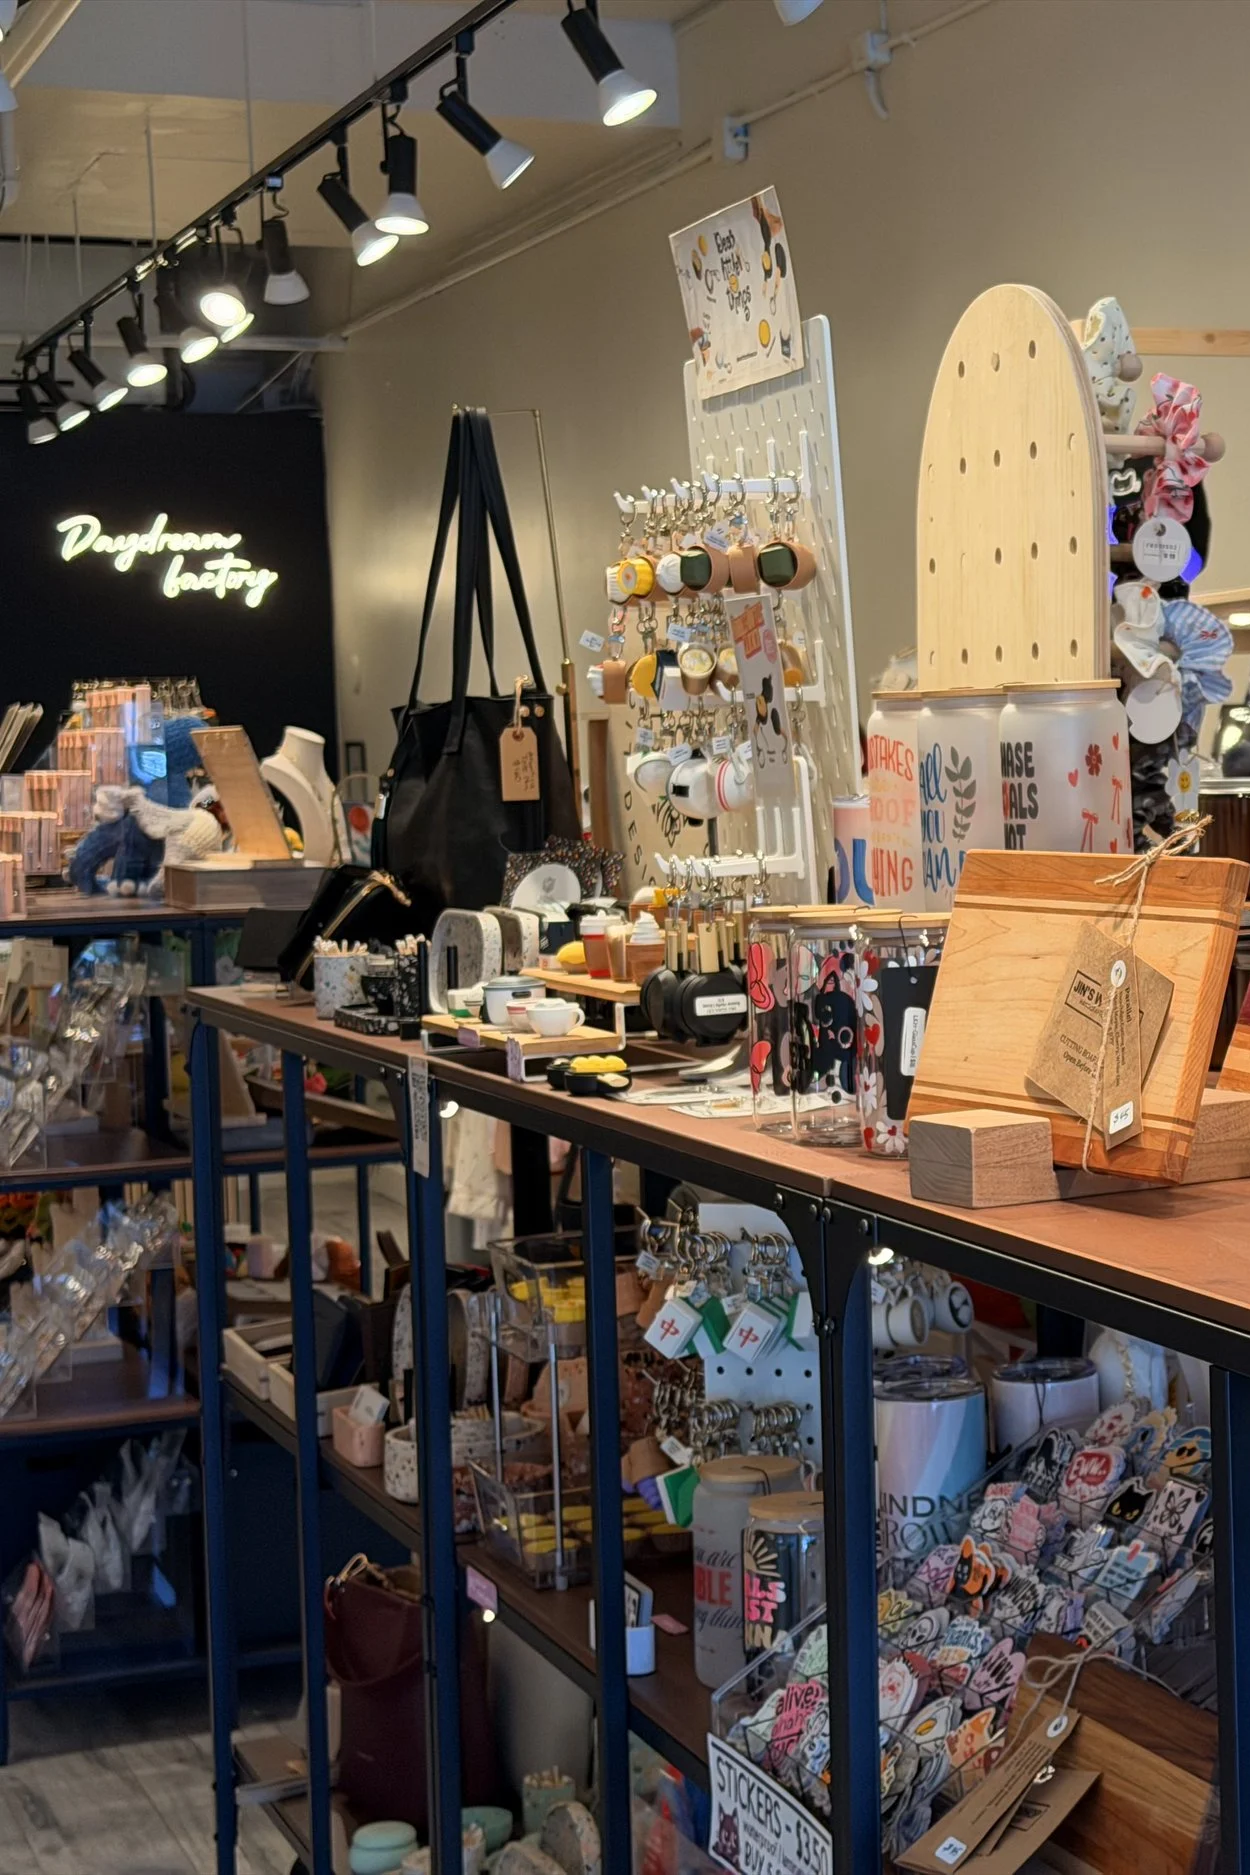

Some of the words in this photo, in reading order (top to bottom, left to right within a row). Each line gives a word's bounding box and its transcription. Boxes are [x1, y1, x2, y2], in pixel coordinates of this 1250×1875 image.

[56, 512, 242, 573] Daydream
[162, 553, 280, 609] factory
[660, 1319, 680, 1342] 中
[738, 1326, 760, 1348] 中
[717, 1756, 781, 1840] STICKERS
